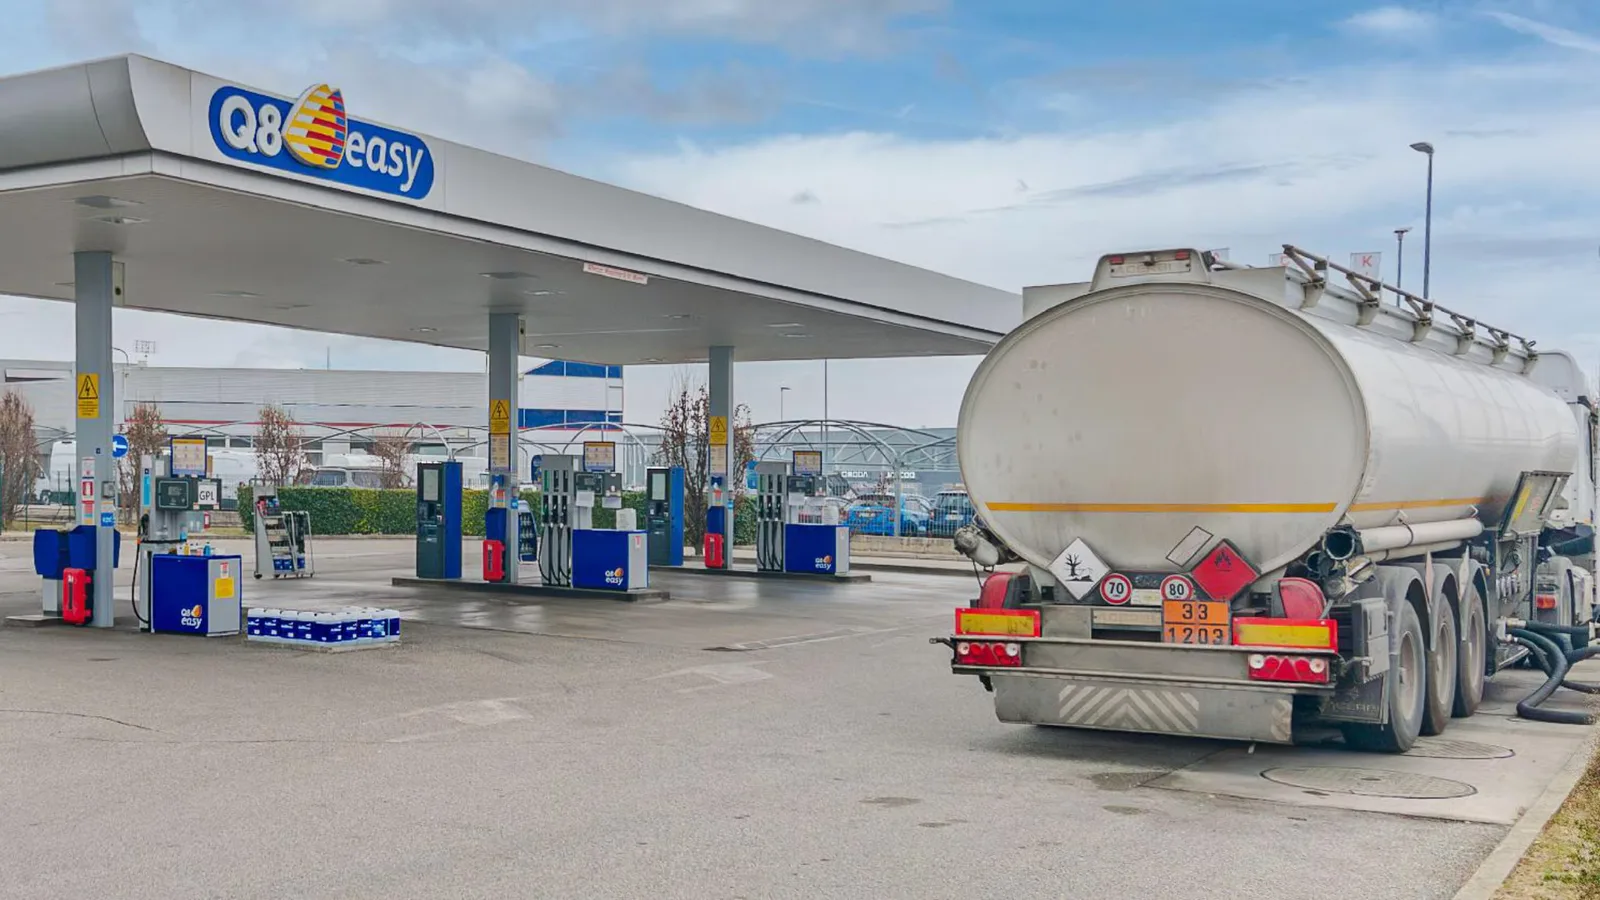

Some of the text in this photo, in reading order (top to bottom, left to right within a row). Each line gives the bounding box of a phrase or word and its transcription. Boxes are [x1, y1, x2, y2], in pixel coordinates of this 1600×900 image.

[220, 95, 423, 192] Q8 easy
[1362, 255, 1372, 267] K
[200, 490, 215, 501] GPL
[605, 577, 624, 586] easy
[1108, 582, 1125, 595] 70
[1169, 583, 1185, 596] 80
[1182, 603, 1208, 620] 33
[181, 616, 203, 629] easy
[1168, 627, 1223, 645] 1203
